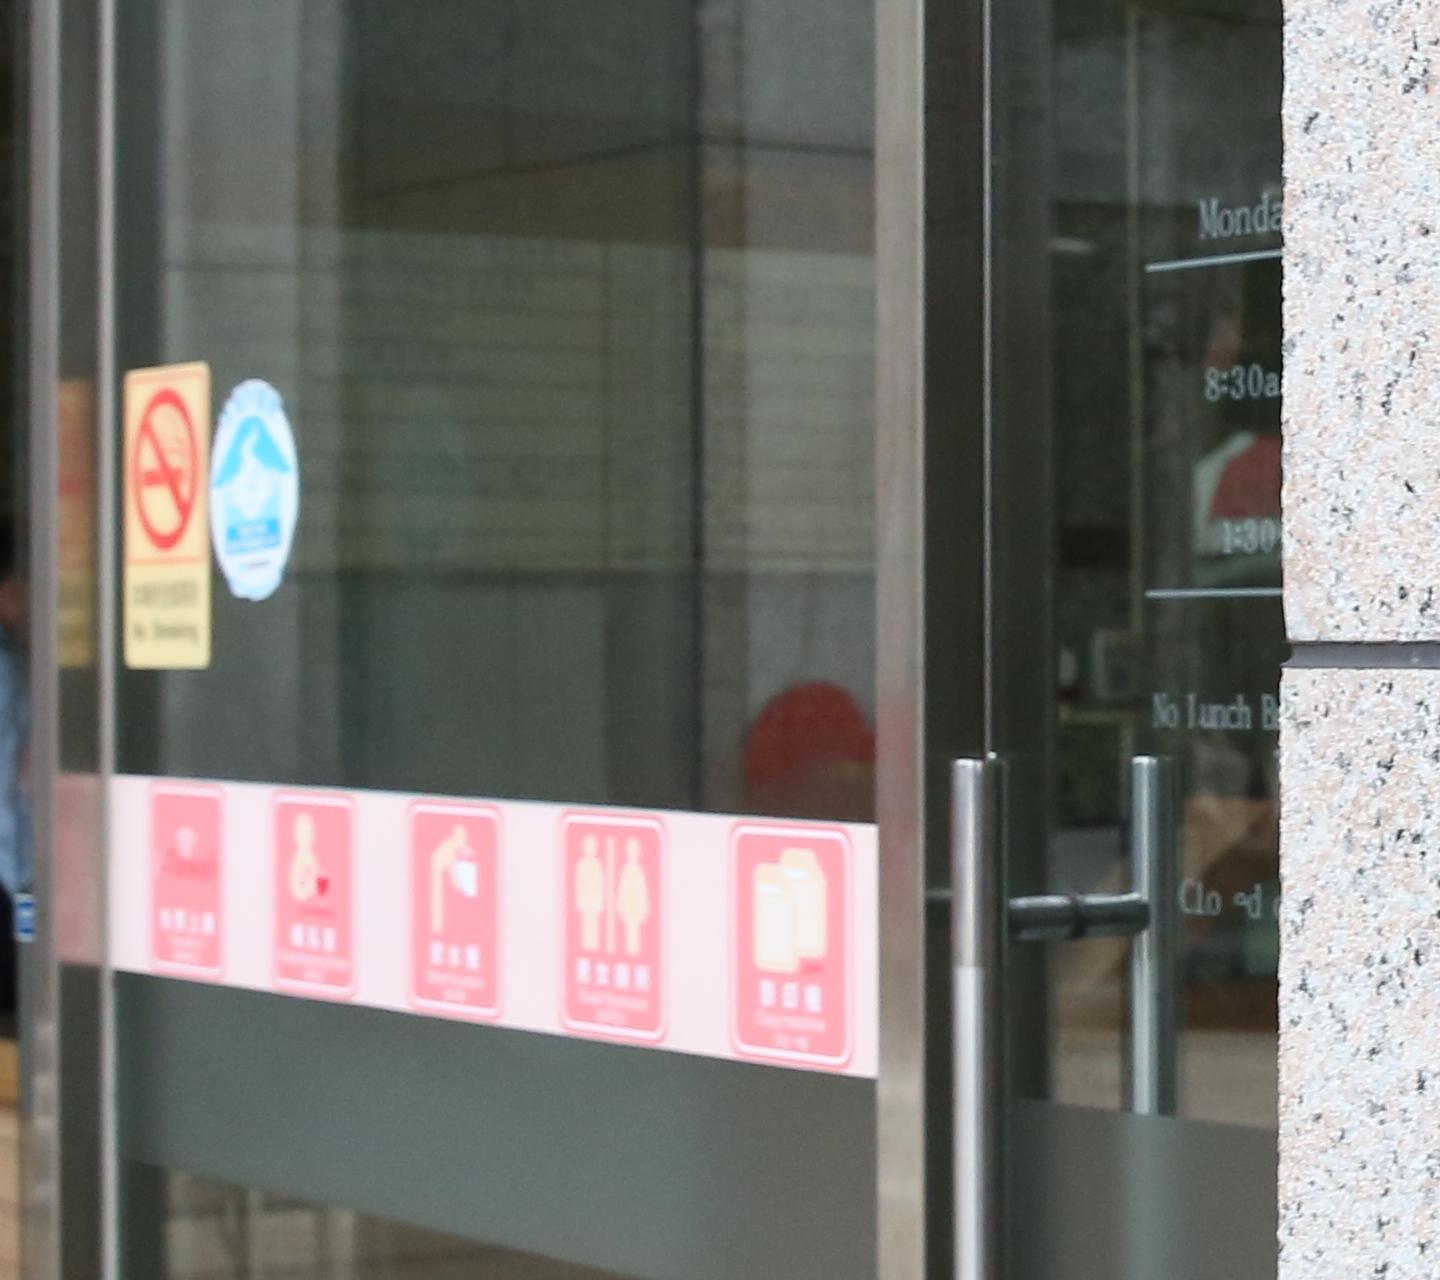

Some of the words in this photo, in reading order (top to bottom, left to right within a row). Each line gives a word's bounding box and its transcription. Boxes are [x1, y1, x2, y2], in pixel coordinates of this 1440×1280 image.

[1198, 192, 1283, 240] Monda
[1204, 363, 1282, 403] 8:30a
[1222, 518, 1280, 556] 1:30
[1152, 692, 1180, 729] No
[1261, 692, 1279, 730] B
[1179, 876, 1263, 920] Cloed
